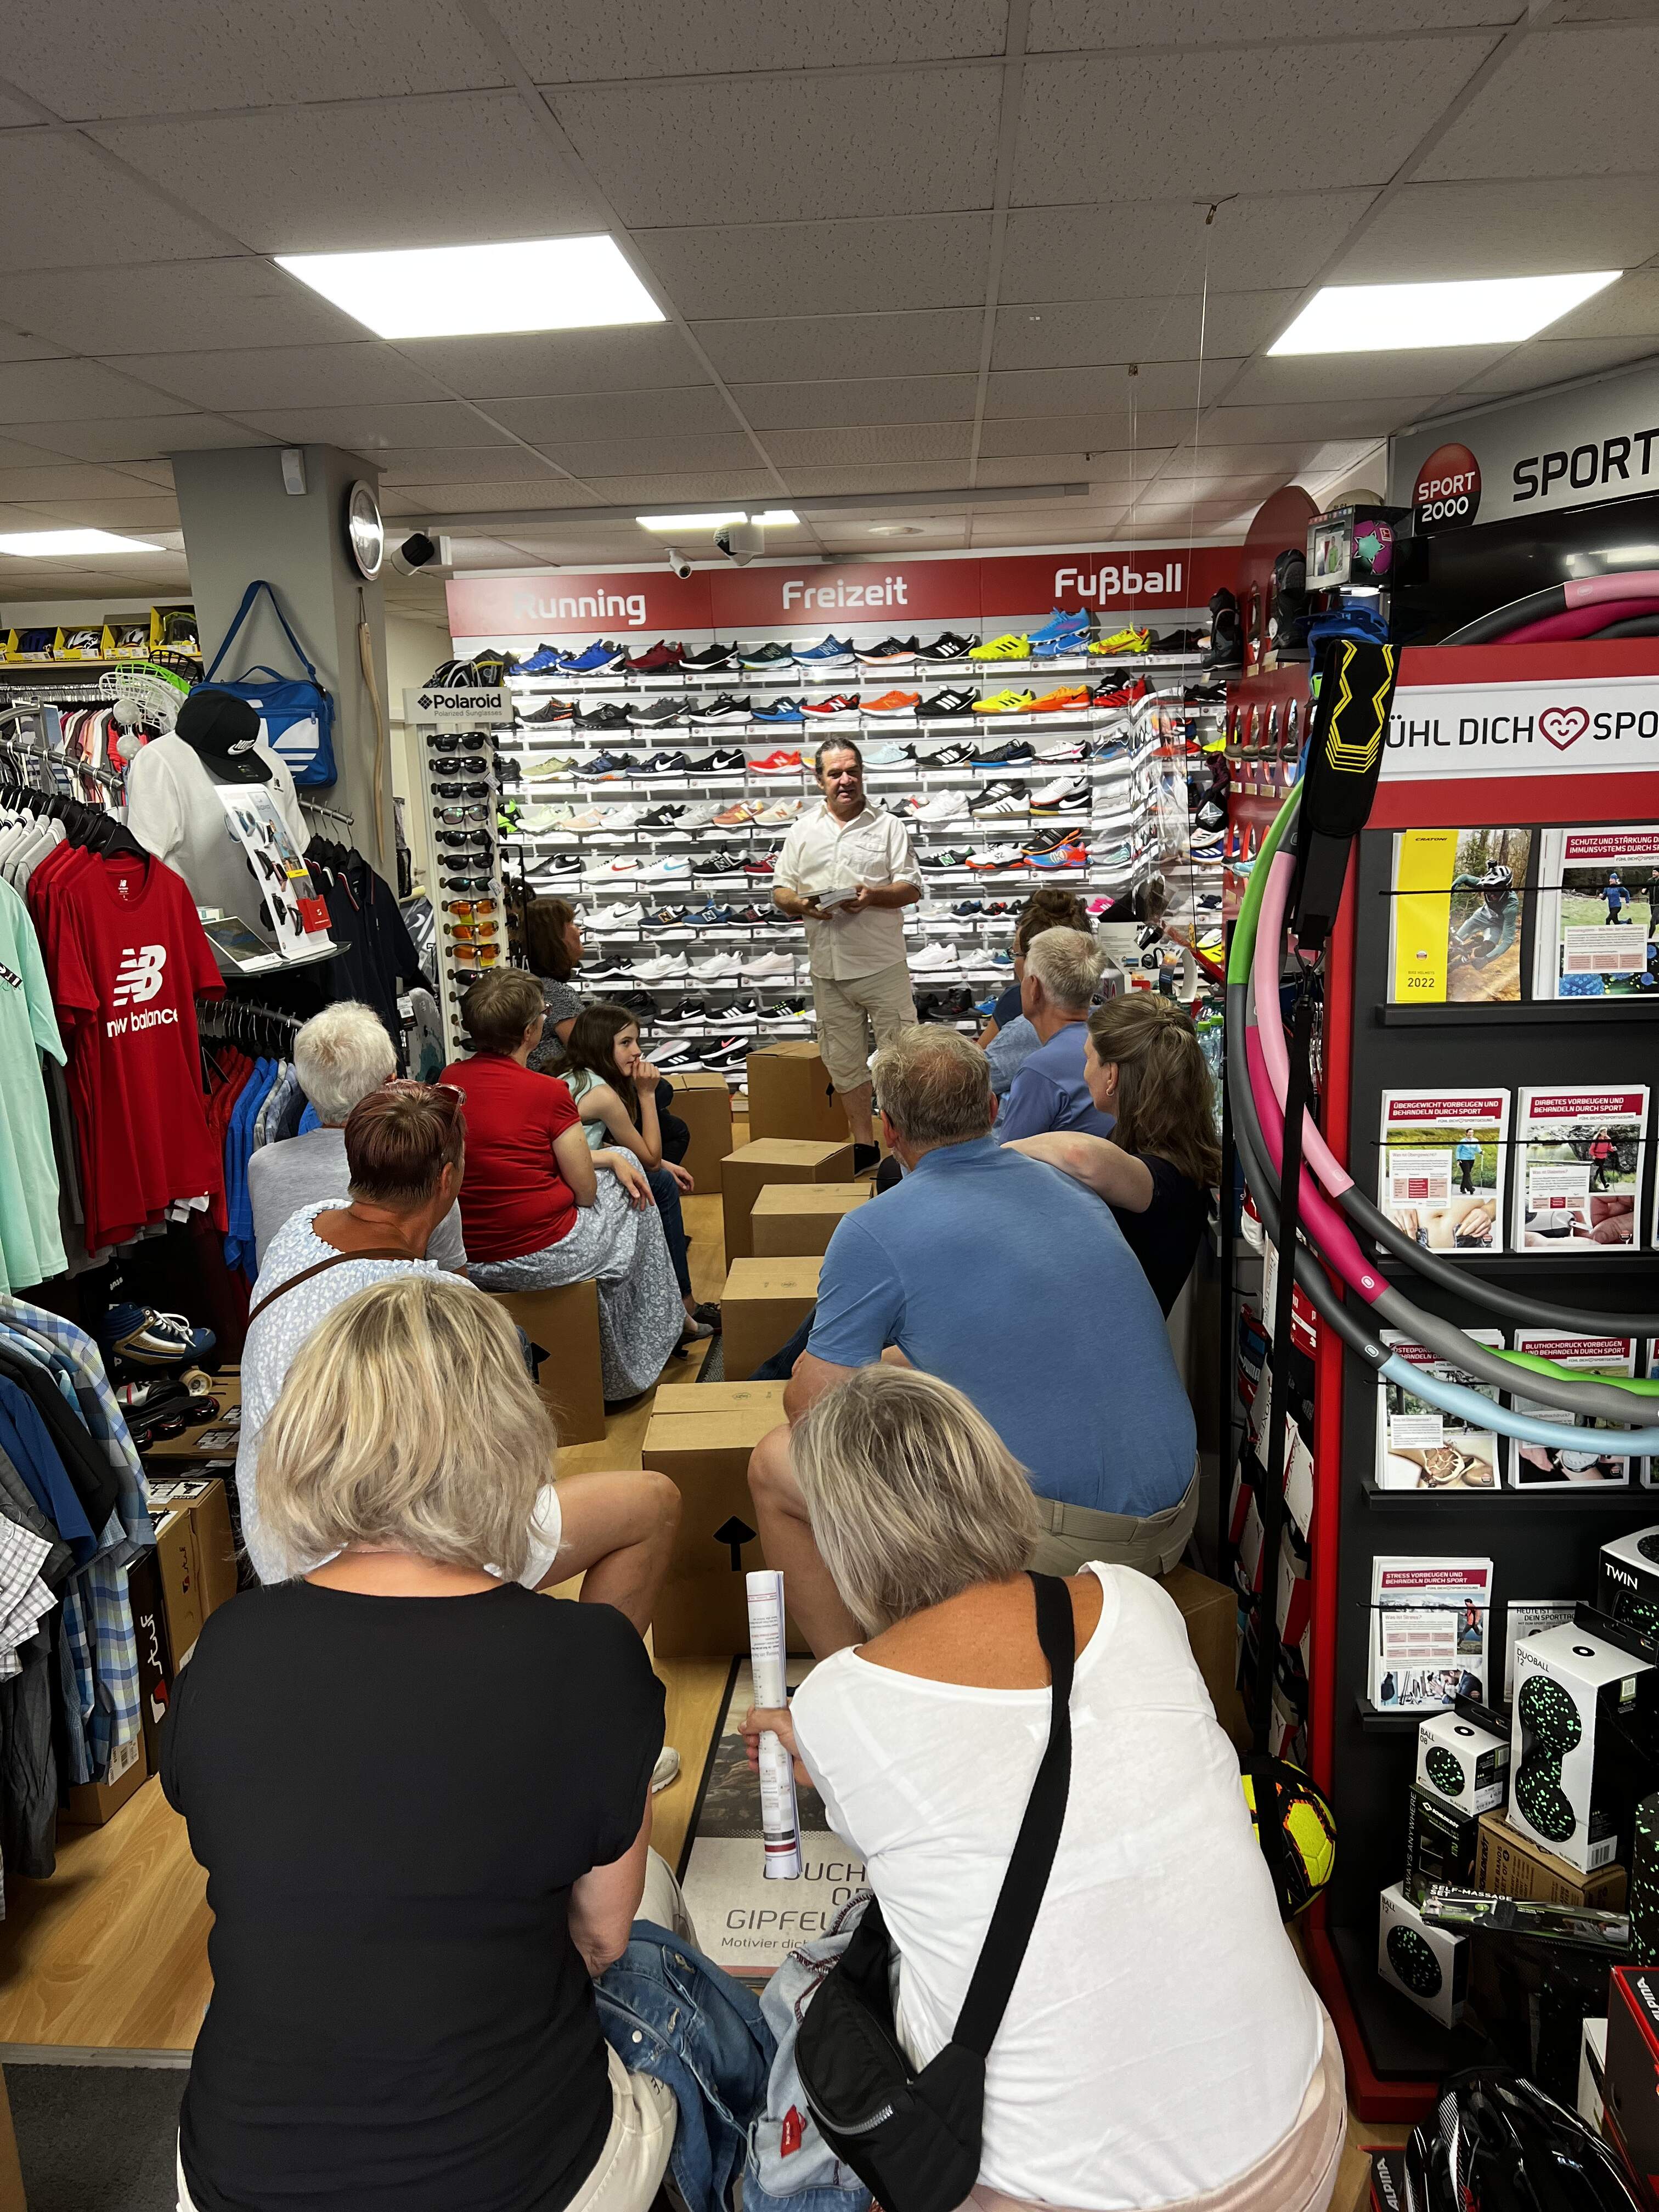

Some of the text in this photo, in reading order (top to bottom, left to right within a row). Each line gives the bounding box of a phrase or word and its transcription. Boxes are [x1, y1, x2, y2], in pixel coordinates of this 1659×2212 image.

[1513, 428, 1659, 502] SPORT
[1418, 471, 1475, 501] SPORT
[1423, 497, 1469, 522] 2000
[783, 575, 908, 610] Freizeit
[1055, 563, 1181, 605] Fußball
[433, 694, 501, 709] Polaroid
[1386, 710, 1658, 748] ÜHL DICH SPO
[1570, 845, 1626, 854] IMMUNSYSTEMS
[1408, 978, 1435, 988] 2022
[1605, 1562, 1638, 1590] TWIN
[1516, 1657, 1525, 1667] 12
[1517, 1647, 1549, 1672] DUOBALL
[1420, 1735, 1427, 1744] 08
[1421, 1728, 1435, 1742] BALL
[1408, 1791, 1417, 1853] ANYWHERE
[1432, 1884, 1513, 1901] SELF-MASSAGE
[1381, 1896, 1396, 1912] BALL
[1382, 1905, 1389, 1914] 12
[721, 1937, 779, 1948] Motivier
[1377, 2157, 1400, 2211] ALPINA
